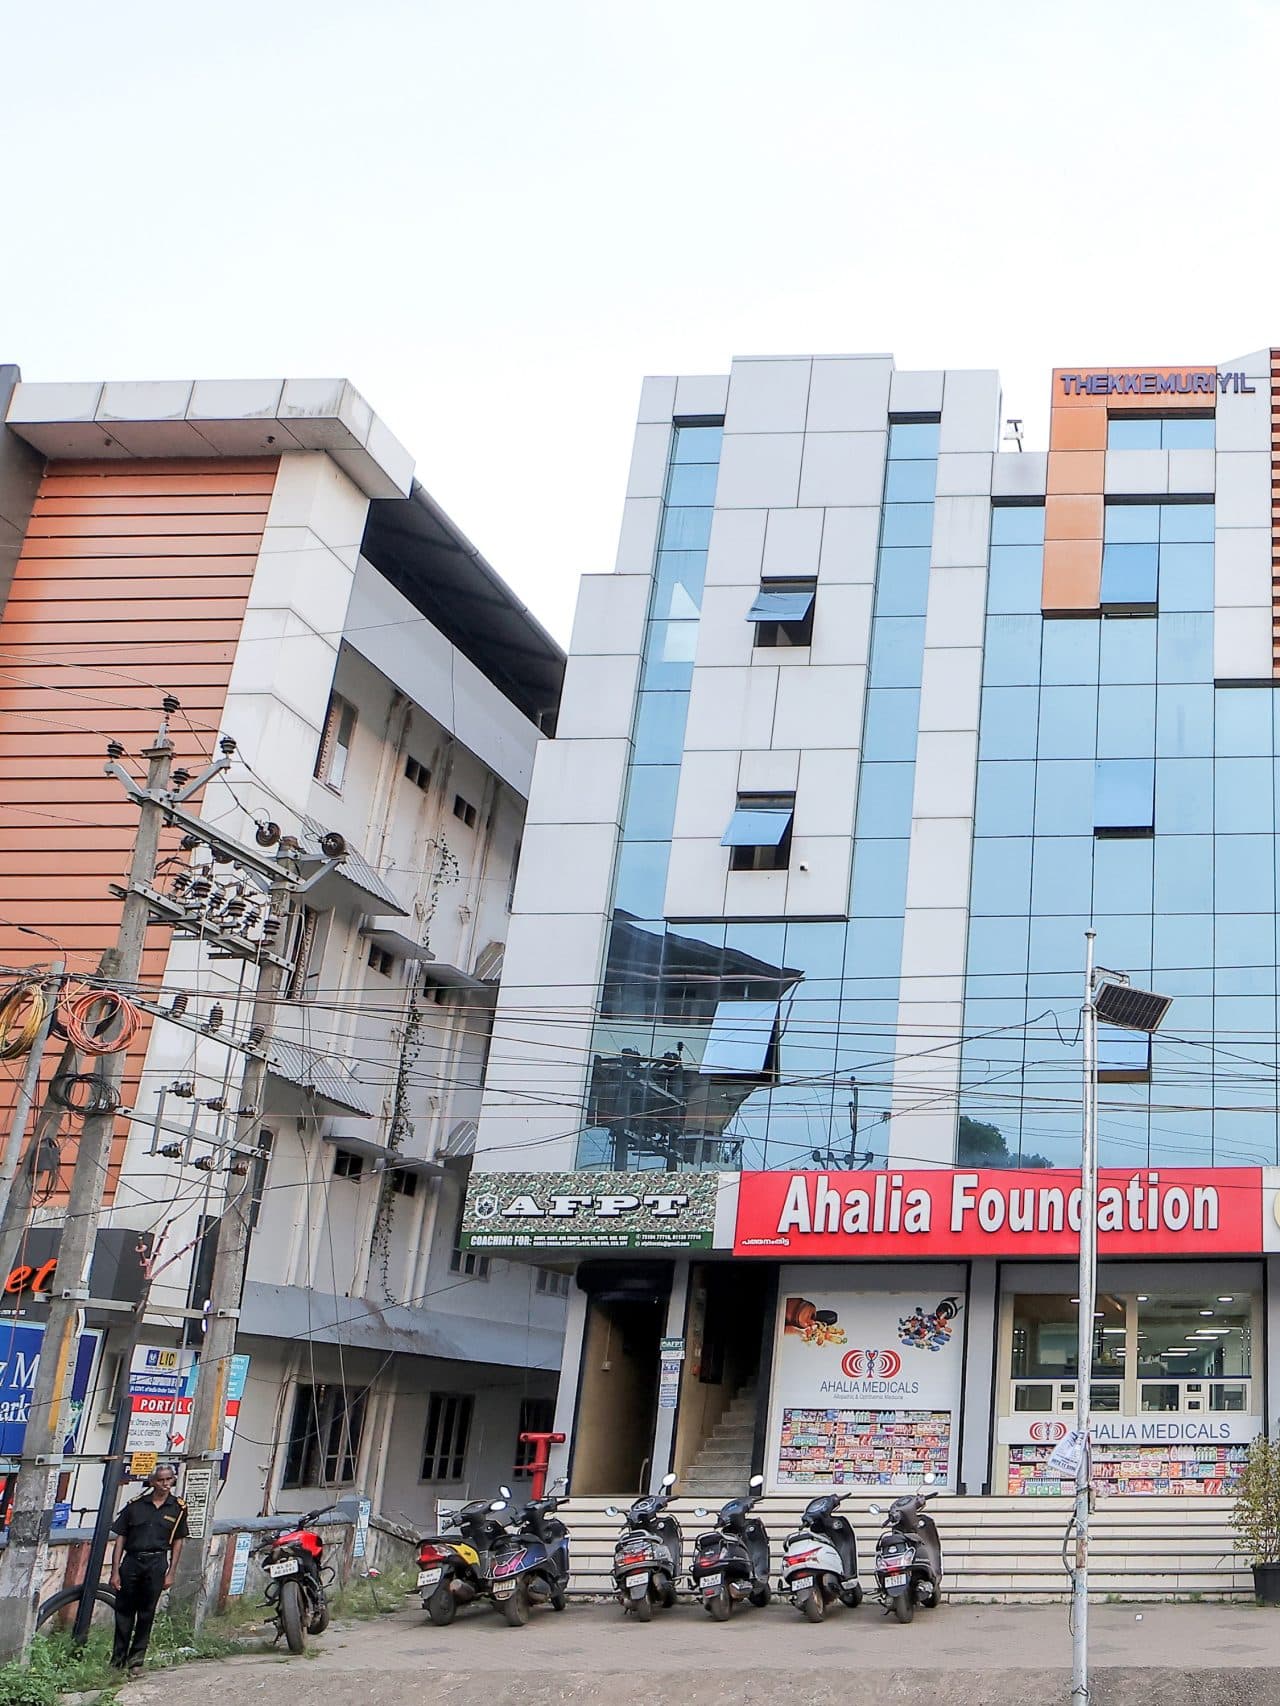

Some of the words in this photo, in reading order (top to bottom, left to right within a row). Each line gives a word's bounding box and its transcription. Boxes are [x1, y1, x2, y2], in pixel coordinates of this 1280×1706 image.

[1060, 372, 1256, 395] THEKKEMURIYIL
[501, 1194, 690, 1218] AFPT
[777, 1174, 933, 1233] Ahalia
[470, 1235, 513, 1246] COACHING
[159, 1352, 175, 1367] LIC
[820, 1380, 860, 1393] AHALIA
[862, 1381, 919, 1394] MEDICALS
[1089, 1423, 1137, 1439] HALIA
[1141, 1423, 1231, 1439] MEDICALS
